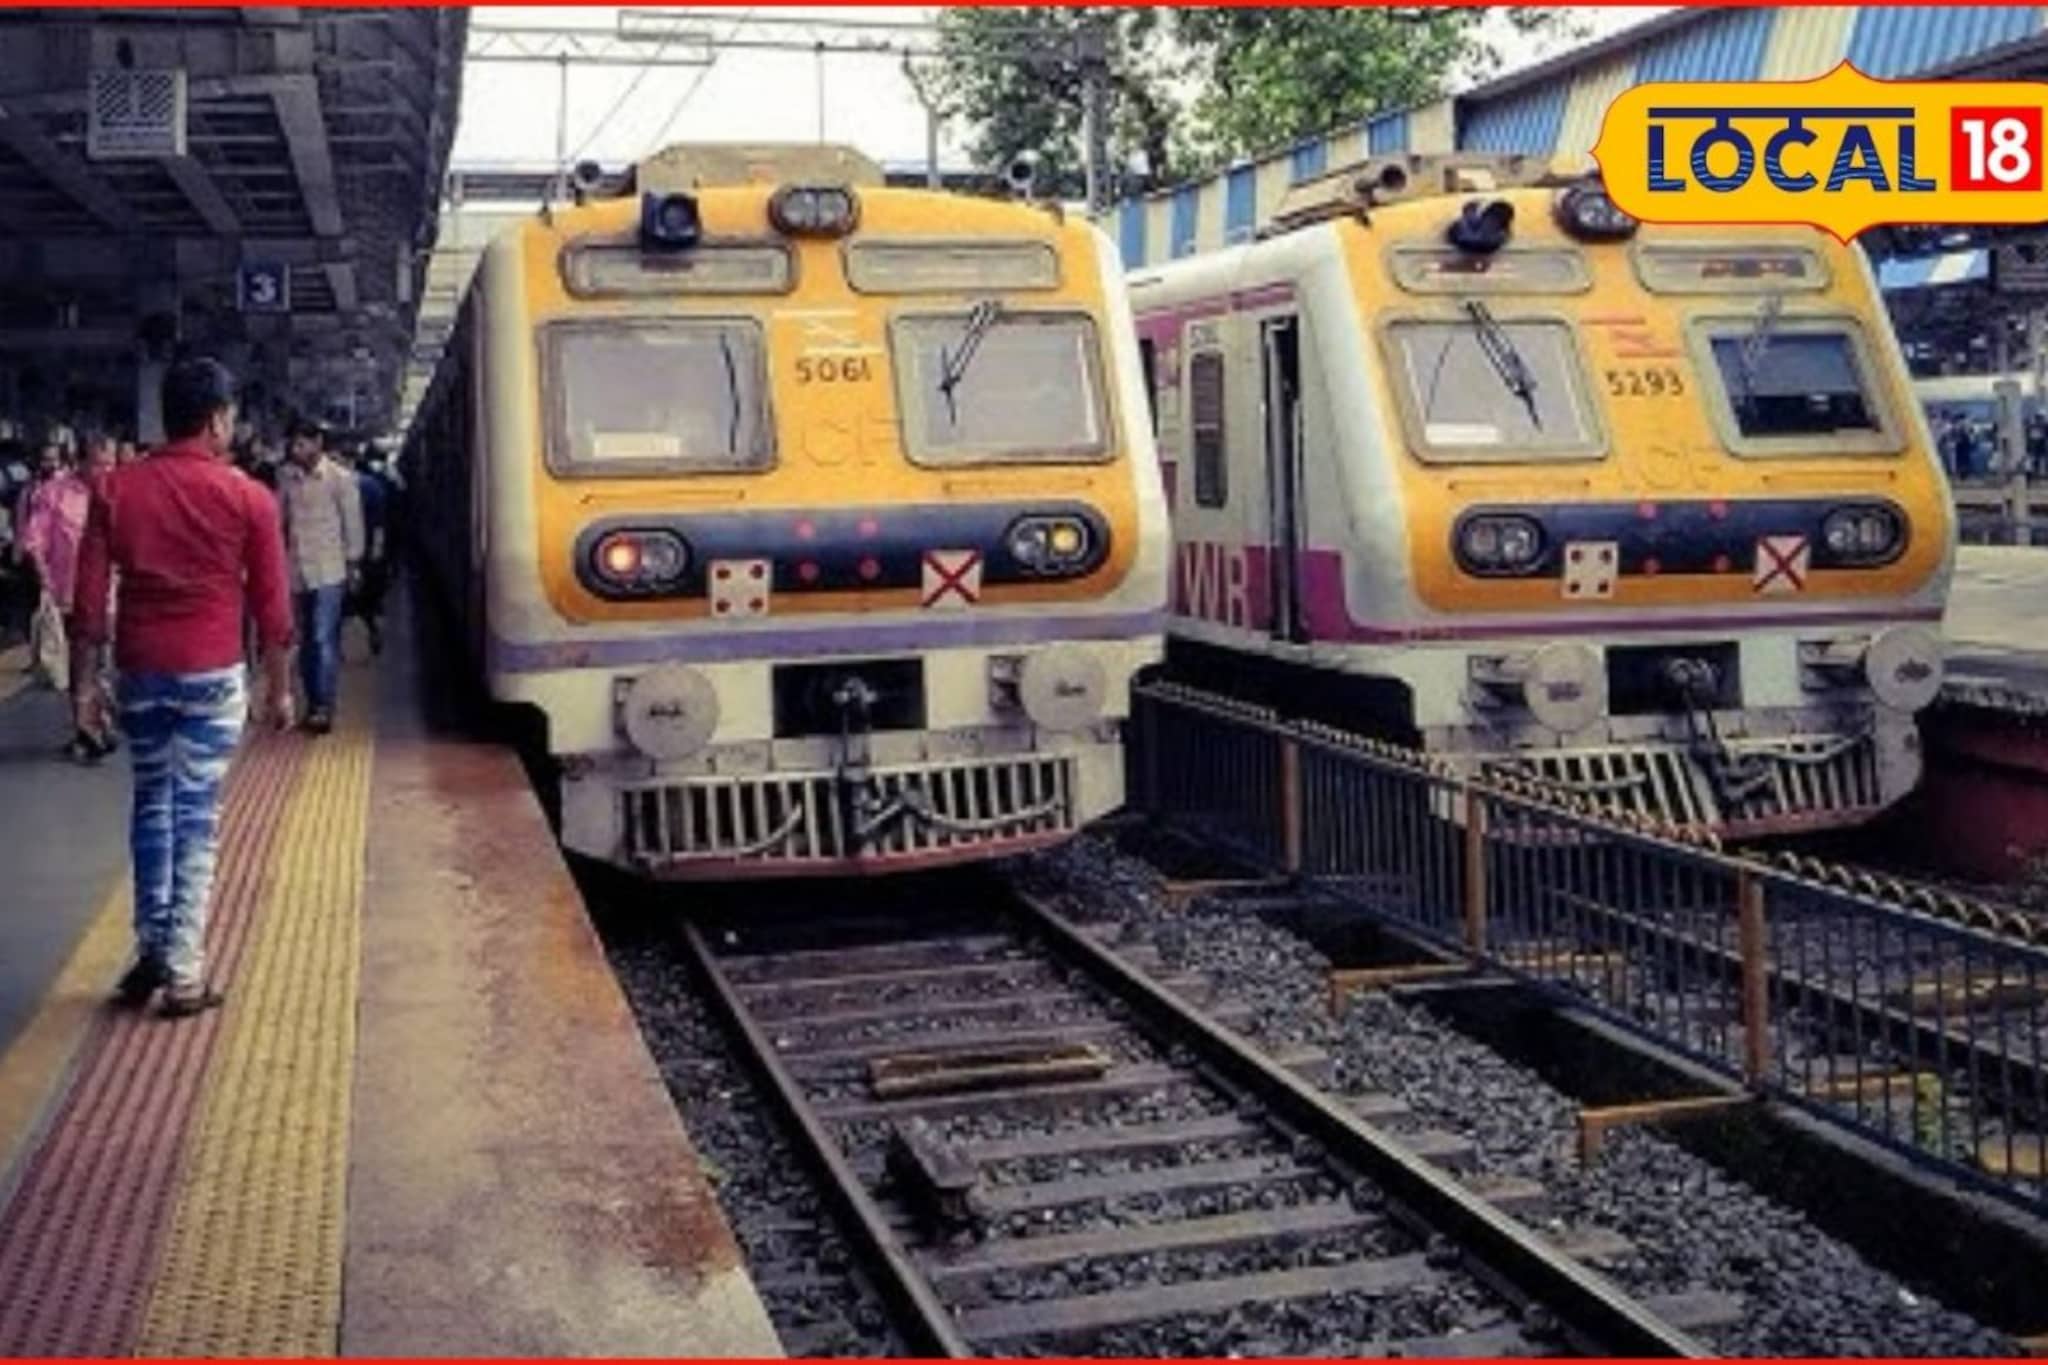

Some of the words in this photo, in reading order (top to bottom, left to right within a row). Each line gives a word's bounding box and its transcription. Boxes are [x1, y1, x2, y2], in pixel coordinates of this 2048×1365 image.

[251, 273, 277, 301] 3
[794, 356, 872, 384] 5061
[1605, 369, 1684, 397] 5293
[1180, 540, 1252, 634] WR
